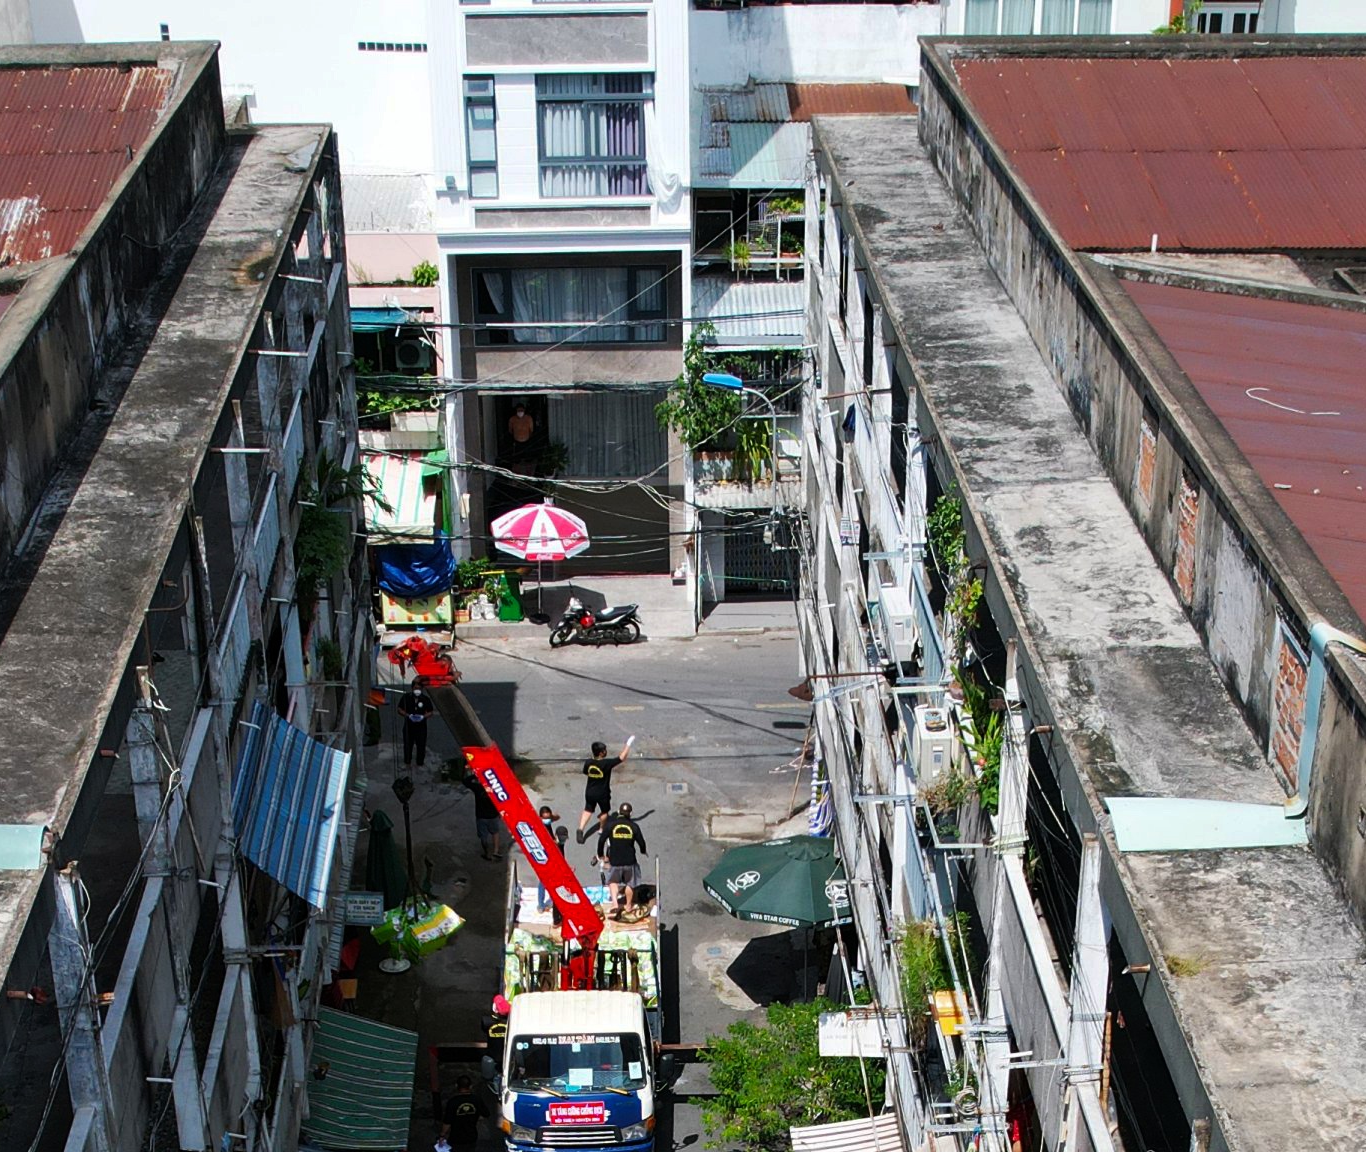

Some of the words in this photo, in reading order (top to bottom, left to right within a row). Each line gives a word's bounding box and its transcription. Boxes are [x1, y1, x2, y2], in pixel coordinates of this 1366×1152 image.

[484, 769, 508, 802] UNIC
[749, 912, 763, 920] VIVA
[763, 914, 778, 923] STAR
[778, 917, 800, 927] COFFEE
